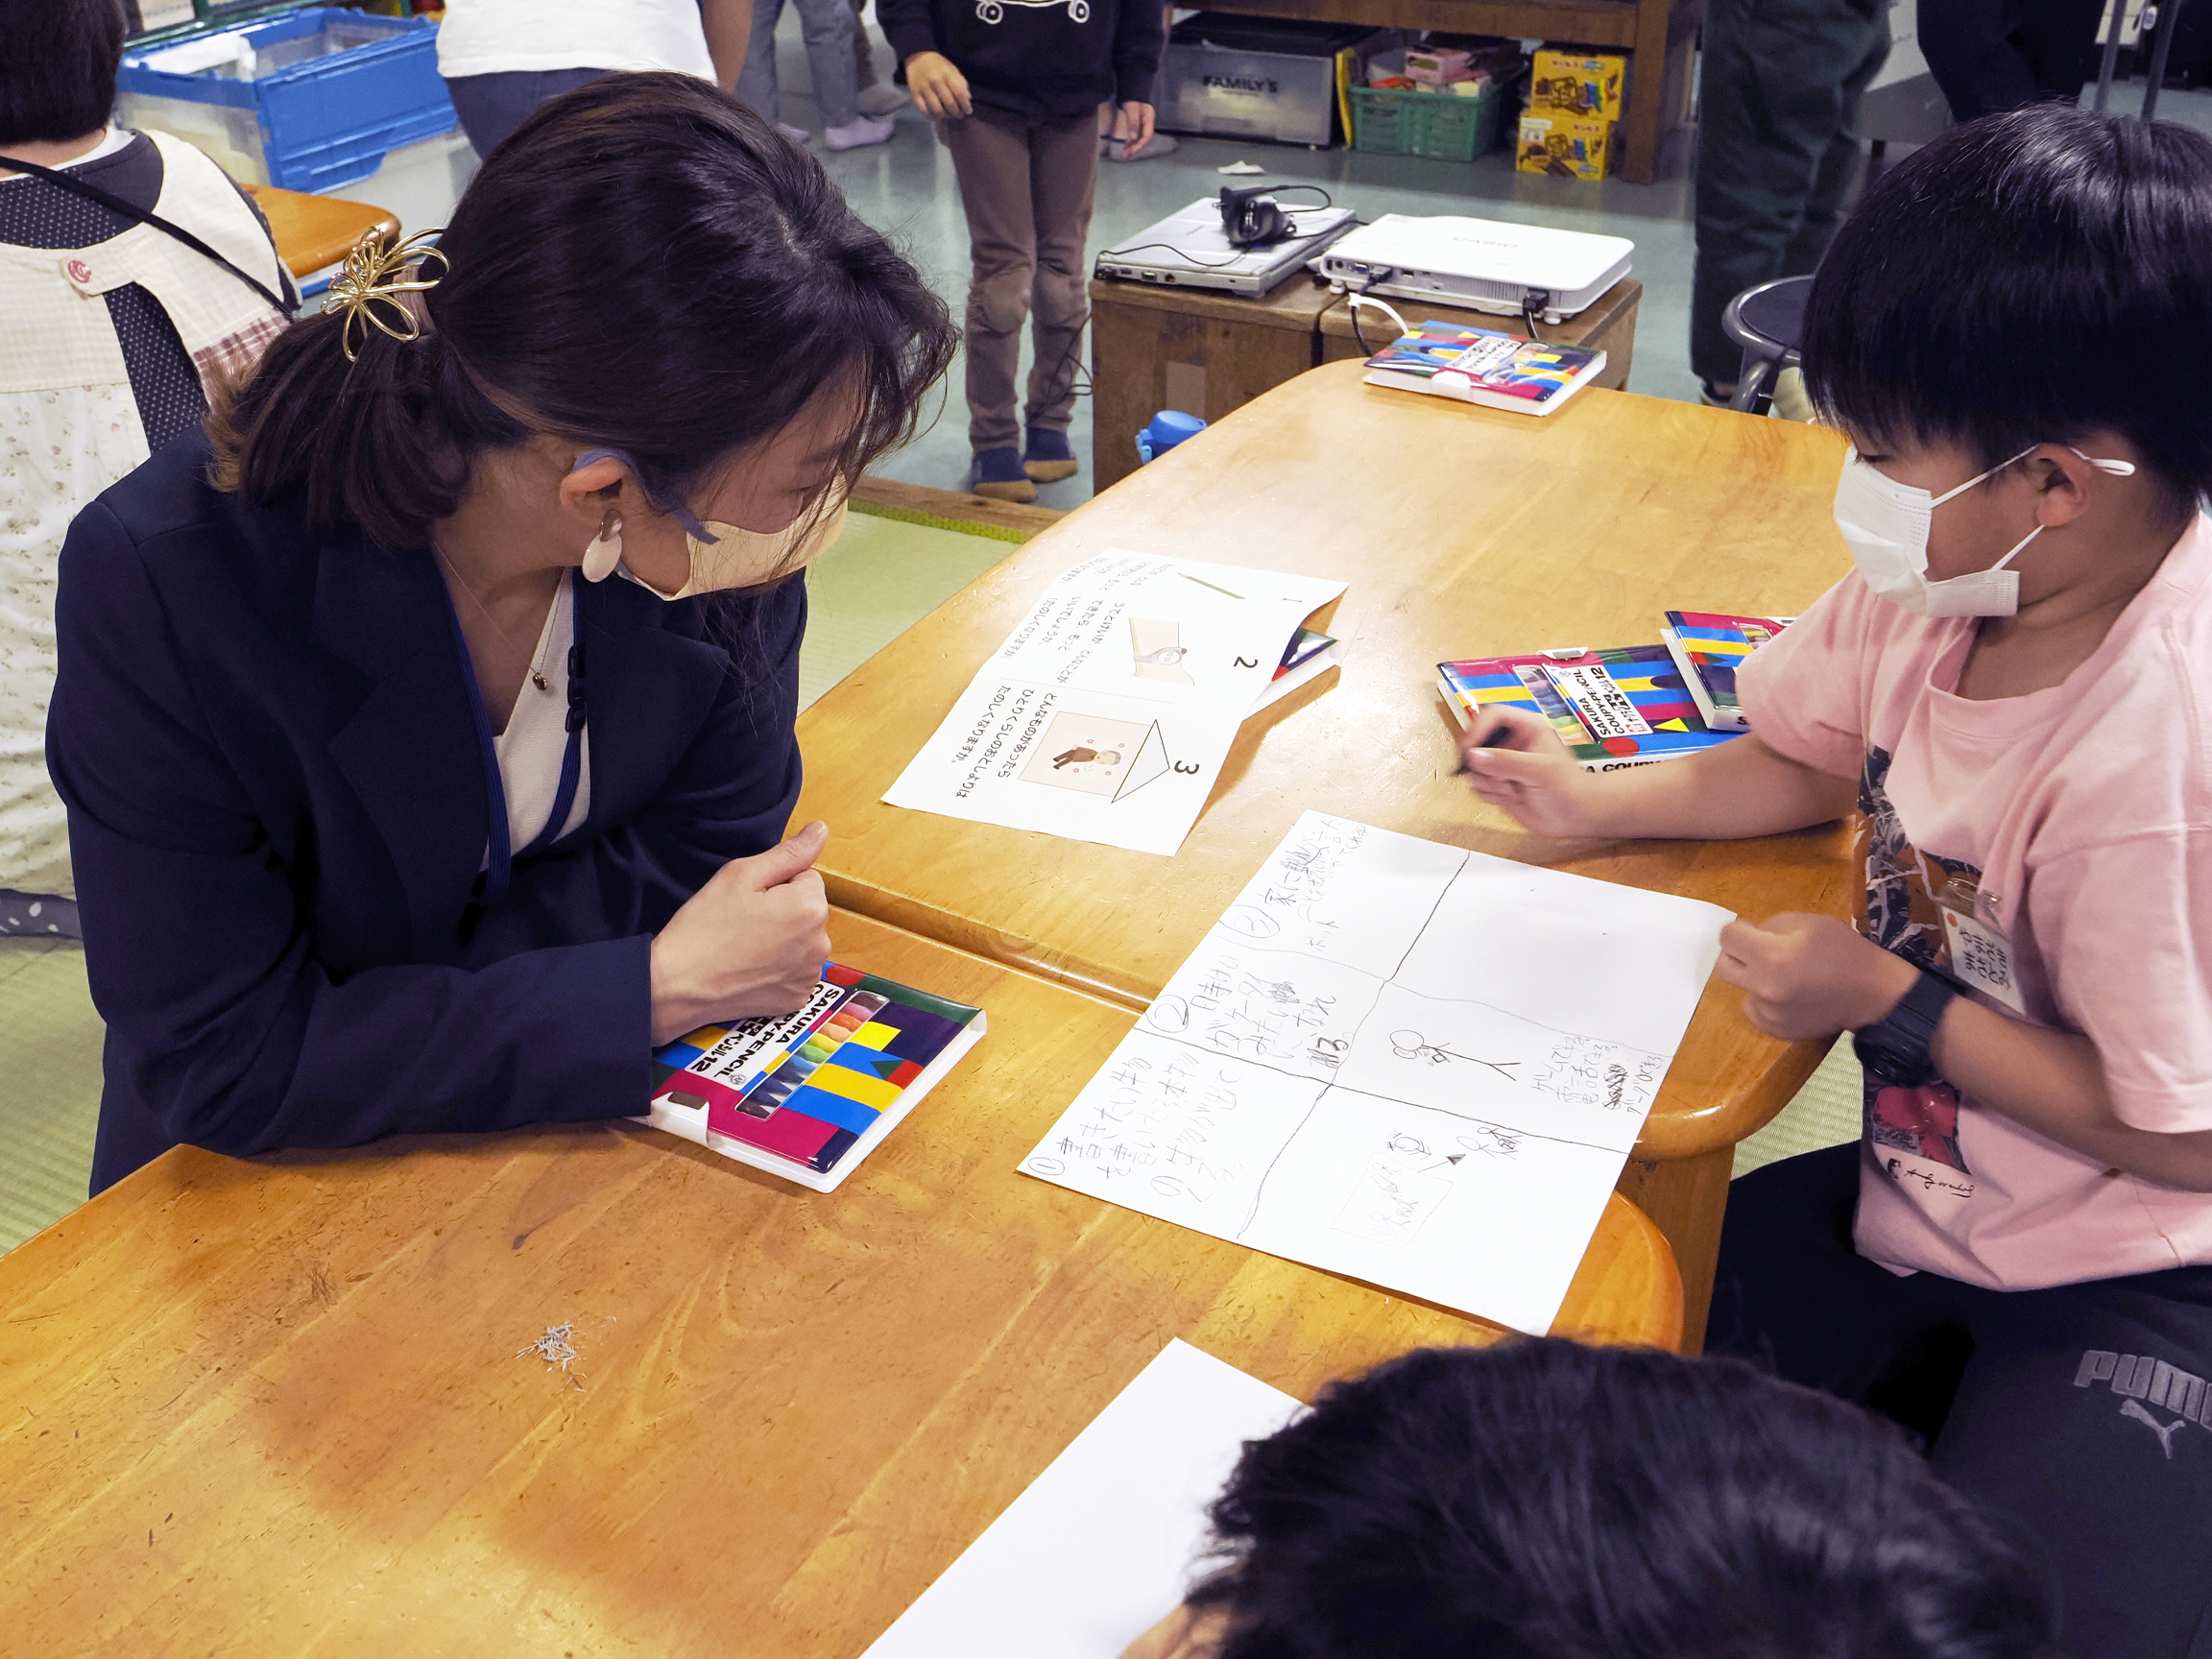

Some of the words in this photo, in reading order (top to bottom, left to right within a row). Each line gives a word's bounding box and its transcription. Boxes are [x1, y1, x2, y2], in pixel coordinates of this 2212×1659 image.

[1234, 656, 1258, 668] 2
[950, 685, 1011, 764] たのしくなりますか。
[998, 692, 1057, 778] どんなものがあったら
[1574, 668, 1625, 735] COUPY-PENCIL
[1578, 697, 1612, 736] SAKURA
[955, 688, 1034, 799] ひとりくらしのおとしよりは
[1174, 760, 1200, 775] 3
[712, 984, 824, 1078] CPY-PENCIL
[775, 988, 840, 1045] SAKURA
